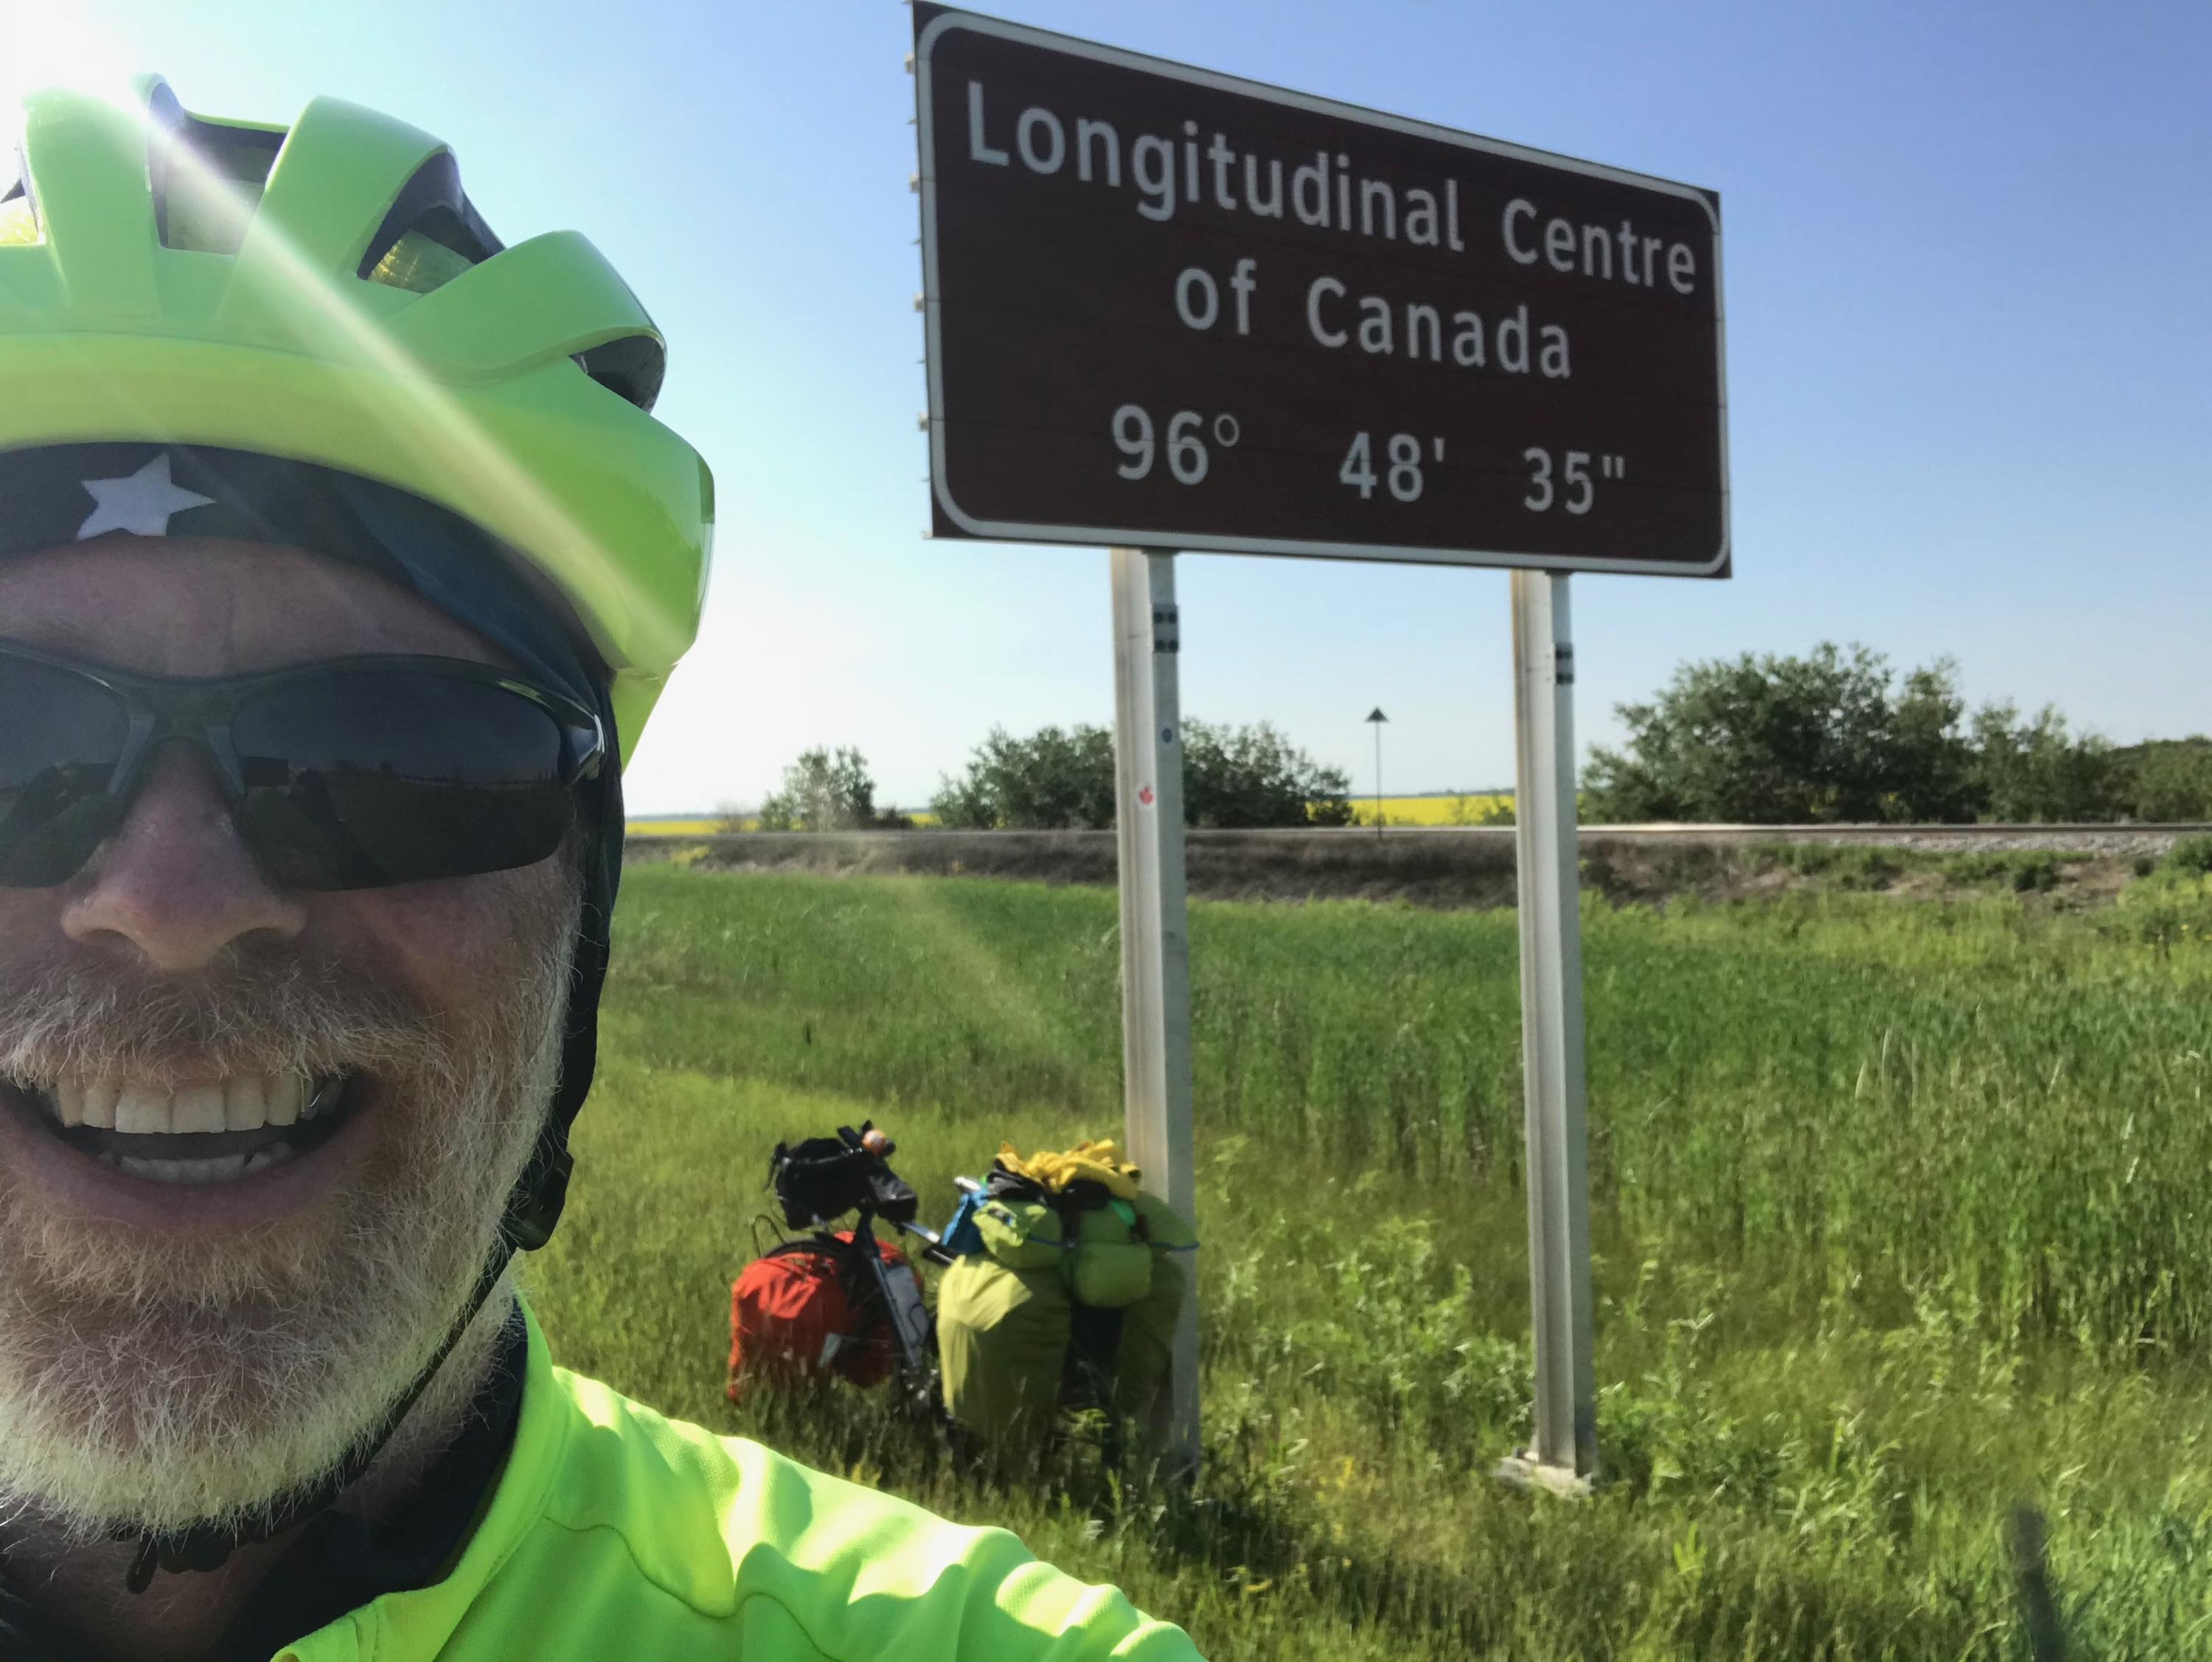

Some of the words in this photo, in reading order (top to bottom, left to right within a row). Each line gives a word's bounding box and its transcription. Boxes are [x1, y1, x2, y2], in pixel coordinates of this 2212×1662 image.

[968, 81, 1464, 251] Longitudinal
[1503, 198, 1696, 293] Centre
[1176, 259, 1256, 335] of
[1307, 277, 1571, 378] Canada
[1339, 431, 1444, 502] 48'
